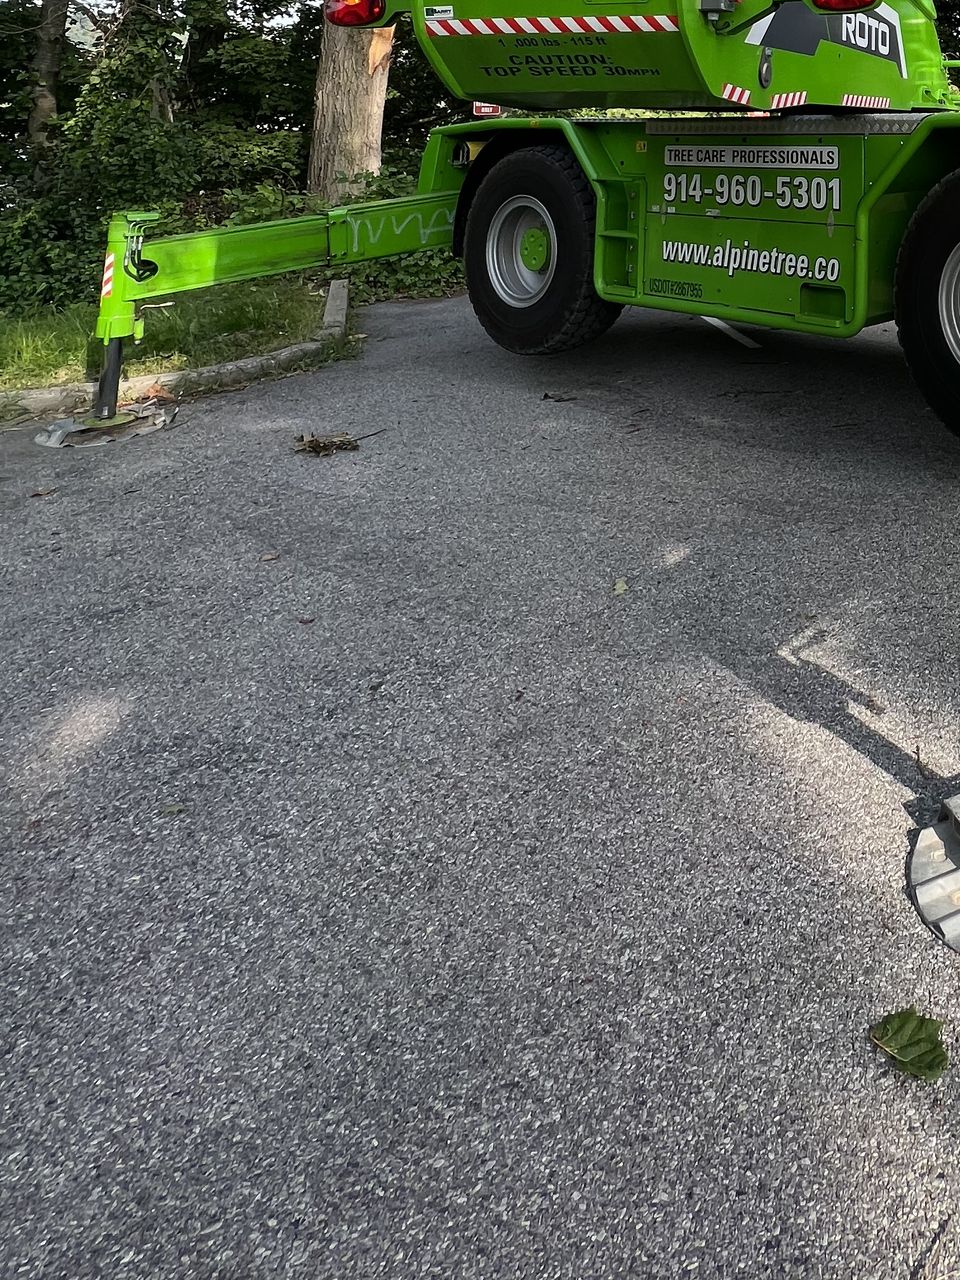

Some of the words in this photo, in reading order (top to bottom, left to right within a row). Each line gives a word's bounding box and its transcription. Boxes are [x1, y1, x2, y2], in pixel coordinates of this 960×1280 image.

[541, 37, 561, 48] lbs
[595, 36, 608, 46] ft
[841, 12, 890, 56] ROTO
[508, 54, 615, 66] CAUTION:
[480, 66, 521, 77] TOP
[528, 66, 597, 77] SPEED
[667, 149, 694, 163] TREE
[696, 149, 726, 164] CARE
[732, 150, 835, 165] PROFESSIONALS
[663, 173, 841, 210] 914-960-5301
[662, 239, 840, 282] www.alpinetree.co
